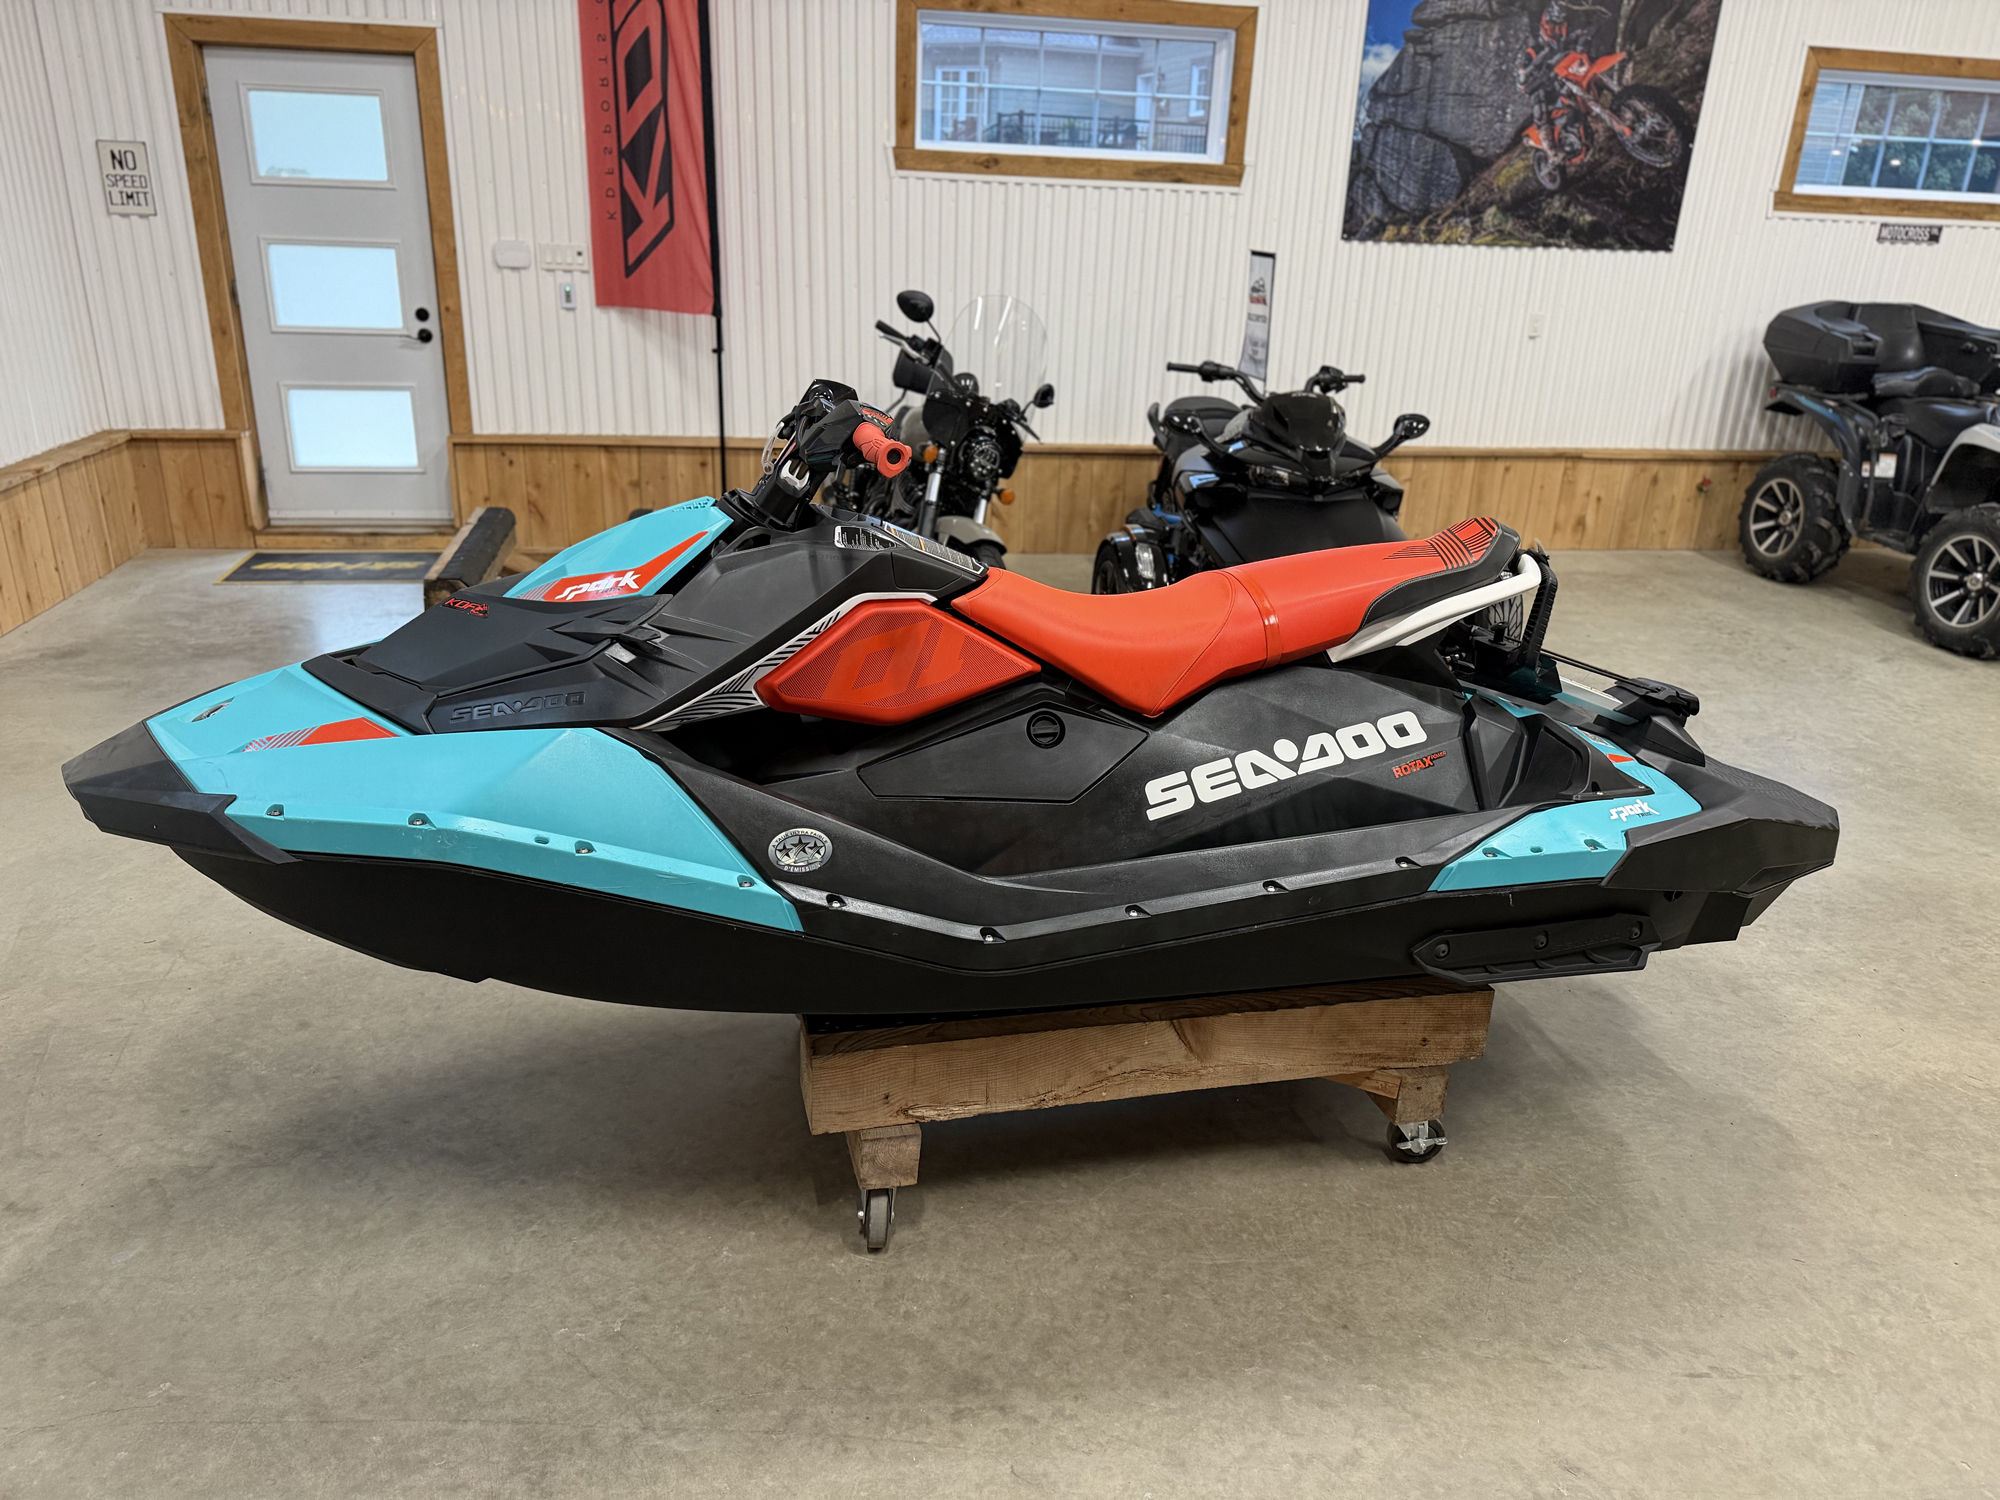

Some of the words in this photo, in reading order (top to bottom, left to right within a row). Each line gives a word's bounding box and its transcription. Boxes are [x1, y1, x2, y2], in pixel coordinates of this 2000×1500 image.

[110, 149, 137, 170] NO
[106, 174, 148, 189] SPEED
[108, 190, 149, 206] LIMIT
[1880, 226, 1930, 241] MOTOCROSS
[555, 571, 641, 600] spark
[1393, 756, 1433, 778] ROTAX
[1610, 799, 1660, 822] spark
